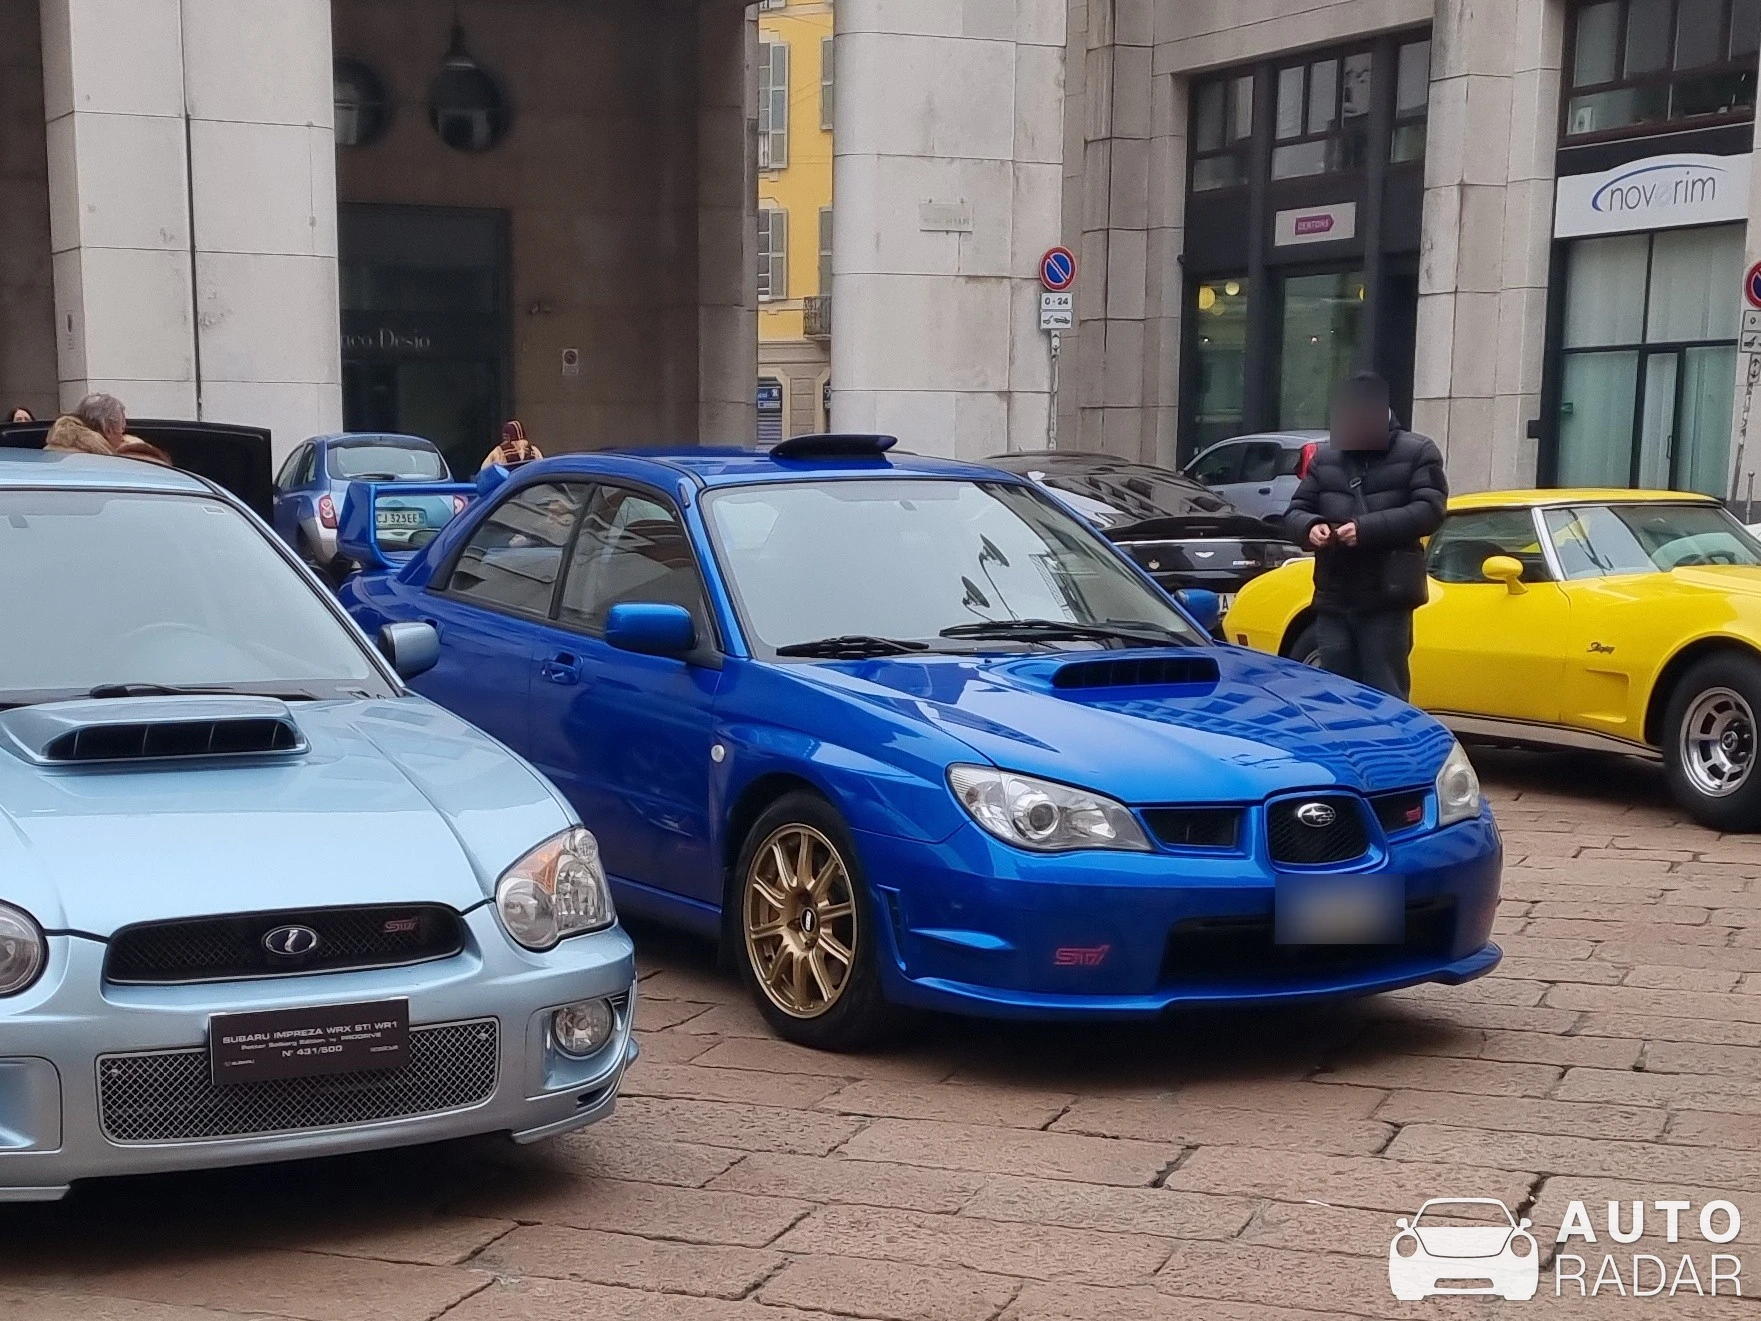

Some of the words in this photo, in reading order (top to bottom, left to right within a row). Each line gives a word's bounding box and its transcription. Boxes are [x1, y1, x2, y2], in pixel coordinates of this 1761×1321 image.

[1057, 297, 1069, 305] 24
[377, 328, 430, 348] Desio
[222, 1032, 270, 1044] SUBARU
[273, 1027, 324, 1039] IMPREZA
[326, 1025, 352, 1034] WRX
[374, 1021, 398, 1030] WR1
[296, 1044, 343, 1055] 431/500
